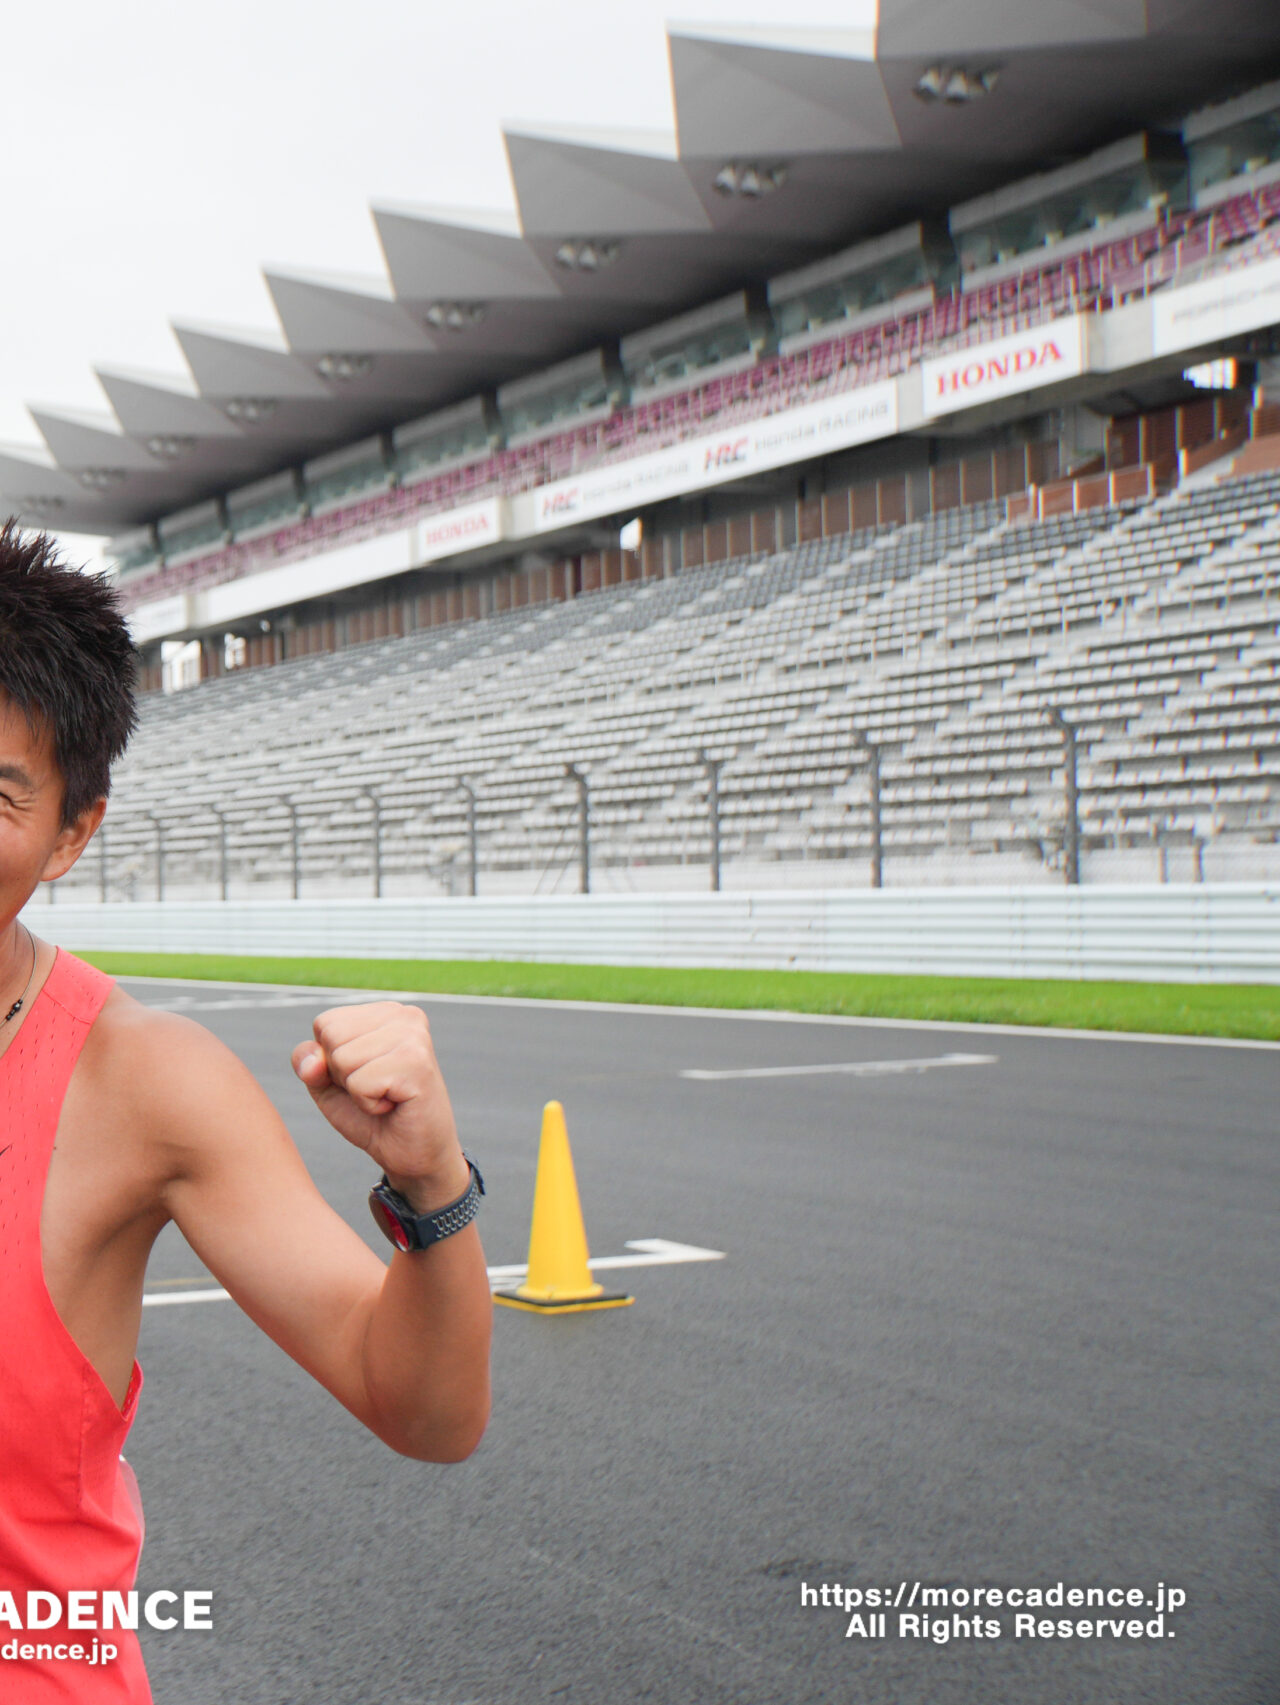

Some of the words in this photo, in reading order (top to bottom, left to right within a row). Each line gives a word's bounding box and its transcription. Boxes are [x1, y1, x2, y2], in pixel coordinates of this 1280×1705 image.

[937, 340, 1062, 395] HONDA
[704, 437, 748, 471] HRC
[425, 513, 489, 545] HONDA
